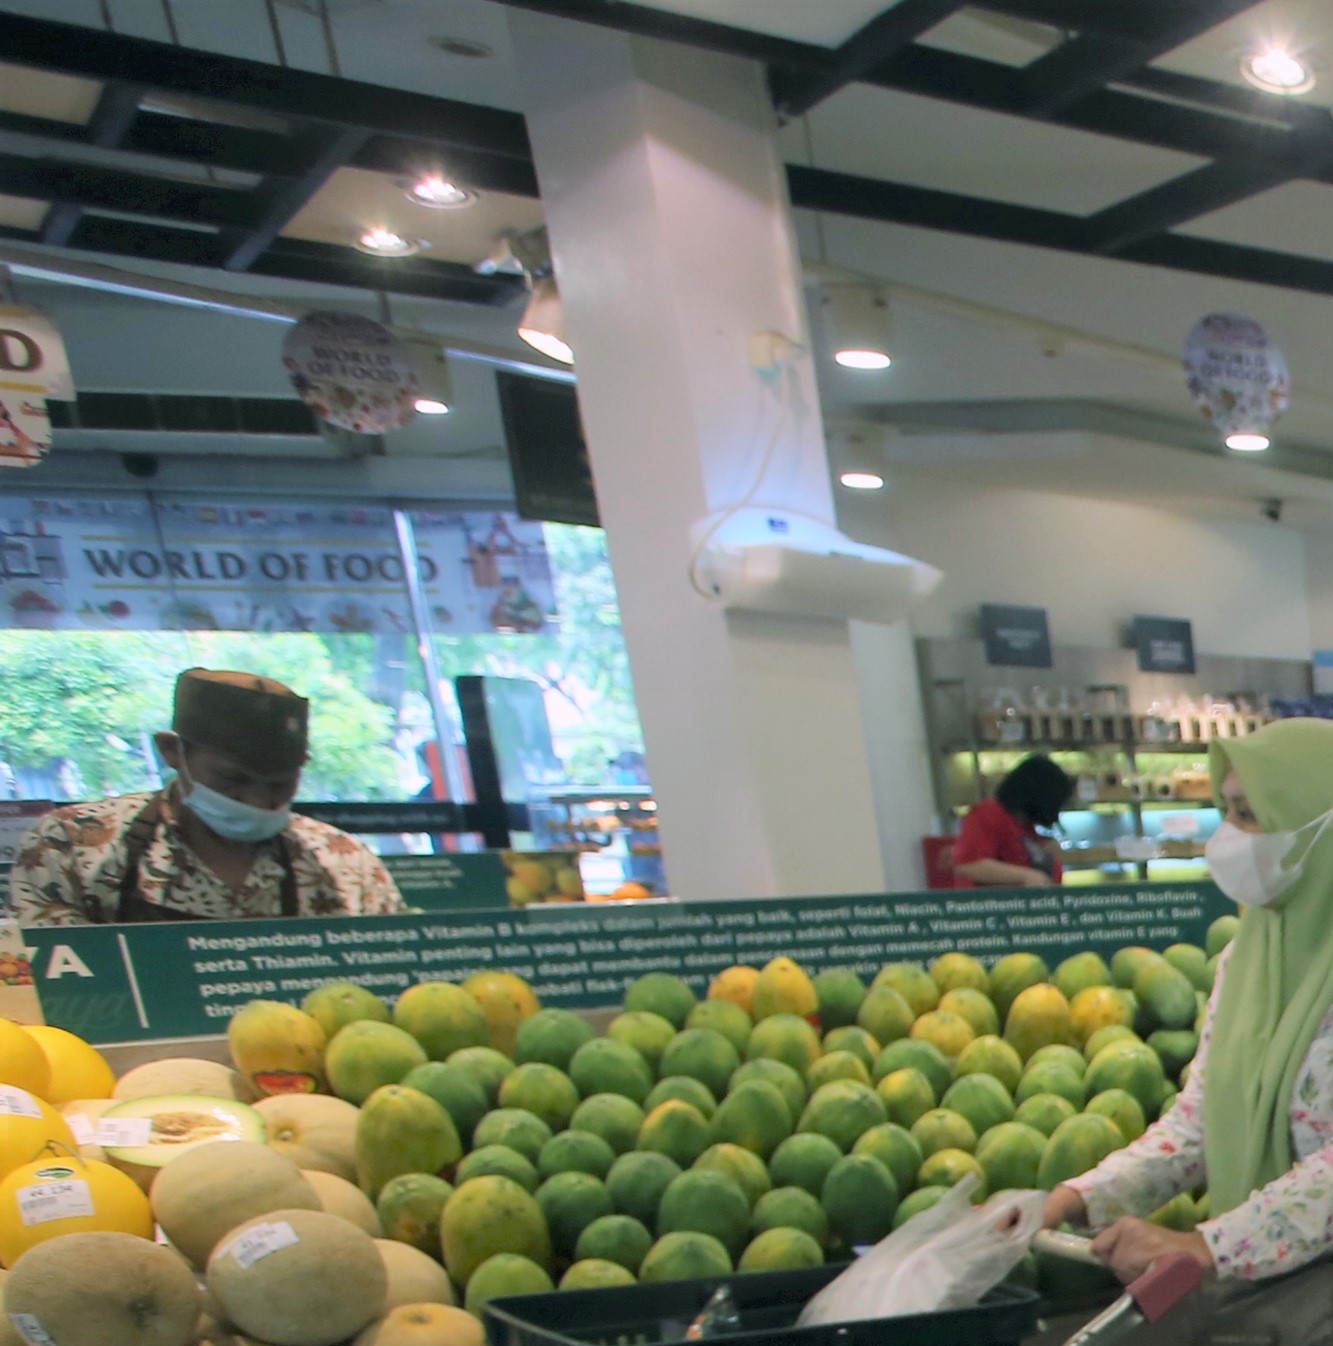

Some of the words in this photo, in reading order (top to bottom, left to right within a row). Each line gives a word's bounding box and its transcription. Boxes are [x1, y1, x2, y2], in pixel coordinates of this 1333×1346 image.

[83, 548, 247, 580] WORLD
[258, 552, 308, 582] OF
[188, 932, 322, 952] Mengandung
[326, 927, 418, 946] beberapa
[421, 924, 495, 940] Vitamin
[194, 958, 247, 975] serta
[252, 954, 339, 972] Thiamin.
[342, 950, 417, 967] Vitamin
[420, 946, 493, 964] penting
[532, 941, 577, 958] yang
[848, 922, 903, 938] Vitamin
[930, 917, 982, 933] Vitamin
[1006, 913, 1058, 928] Vitamin
[1106, 907, 1153, 922] Vitamin
[200, 980, 275, 999] pepaya
